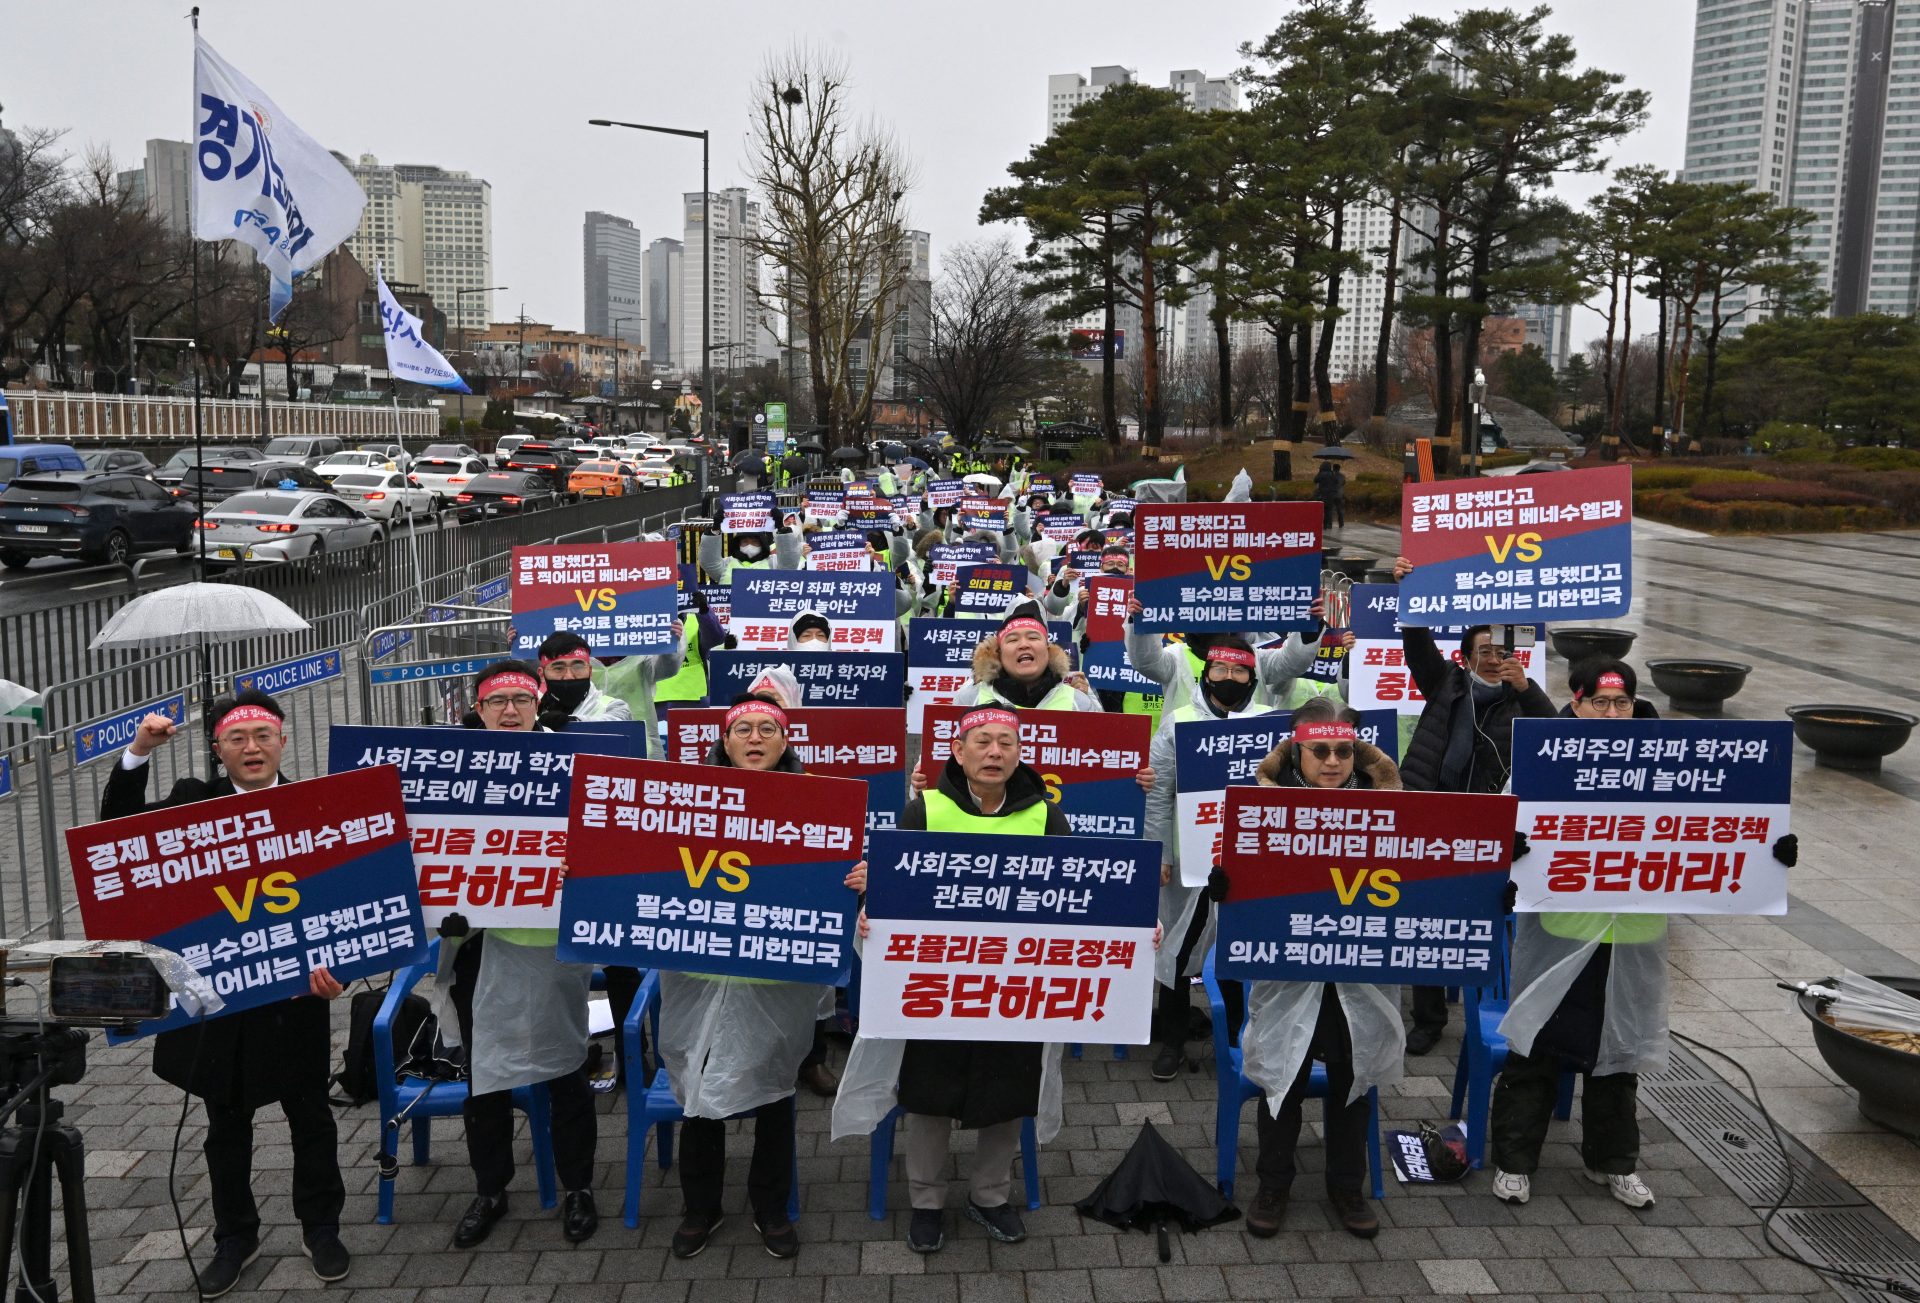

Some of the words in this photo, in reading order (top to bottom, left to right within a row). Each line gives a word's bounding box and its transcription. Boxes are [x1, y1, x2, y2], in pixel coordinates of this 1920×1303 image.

[1412, 494, 1449, 512] 경제
[1456, 488, 1534, 509] 망했다고
[729, 519, 767, 528] 중단하라!
[1144, 516, 1175, 531] 경제
[1181, 515, 1245, 531] 망했다고
[1412, 515, 1430, 532] 돈
[1435, 509, 1513, 530] 찍어내던
[1519, 500, 1622, 524] 베네수엘라
[1143, 534, 1159, 549] 돈
[1163, 533, 1228, 549] 찍어내던
[1233, 532, 1315, 547] 베네수엘라
[1485, 532, 1542, 563] VS
[520, 556, 548, 569] 경제
[553, 554, 610, 571] 망했다고
[812, 552, 837, 560] 포퓰리즘
[816, 560, 861, 571] 중단하라!
[1205, 554, 1251, 580] VS
[519, 572, 533, 585] 돈
[537, 570, 595, 584] 찍어내던
[600, 567, 671, 582] 베네수엘라
[747, 580, 803, 595] 사회주의
[807, 582, 836, 595] 좌파
[840, 582, 881, 596] 학자와
[969, 579, 990, 589] 의대
[993, 581, 1013, 590] 증원
[1456, 569, 1534, 589] 필수의료
[1540, 564, 1622, 585] 망했다고
[575, 588, 616, 611] VS
[768, 597, 812, 613] 관료에
[815, 599, 858, 616] 놀아난
[961, 592, 1015, 606] 중단하라
[1097, 587, 1126, 607] 경제
[1181, 587, 1244, 602] 필수의료
[1249, 586, 1315, 604] 망했다고
[1367, 597, 1399, 613] 사회
[1409, 596, 1448, 613] 의사
[1452, 592, 1532, 611] 찍어내는
[1539, 587, 1622, 607] 대한민국
[1095, 602, 1108, 616] 돈
[1141, 608, 1174, 622] 의사
[1178, 607, 1243, 621] 찍어내는
[1247, 606, 1312, 620] 대한민국
[554, 616, 611, 631] 필수의료
[615, 614, 673, 628] 망했다고
[614, 631, 671, 645] 대한민국
[832, 628, 883, 644] 료정책
[924, 630, 982, 648] 사회주의
[257, 667, 298, 690] POLICE
[300, 660, 322, 680] LINE
[402, 661, 473, 679] POLICE
[799, 664, 833, 679] 좌파
[838, 664, 887, 680] 학자와
[1089, 665, 1116, 680] 의사
[809, 684, 859, 699] 놀아난
[98, 721, 138, 748] POLIC
[679, 725, 719, 743] 경제
[1308, 726, 1335, 736] 의대증원
[798, 746, 897, 763] 베네수엘라
[932, 742, 951, 760] 돈
[1041, 747, 1141, 769] 베네수엘라
[1196, 732, 1276, 758] 사회주의
[1538, 738, 1634, 761] 사회주의
[1639, 739, 1688, 762] 좌파
[1696, 739, 1768, 763] 학자와
[356, 747, 463, 773] 사회주의
[469, 750, 522, 774] 좌파
[1574, 768, 1646, 791] 관료에
[1653, 768, 1726, 791] 놀아난
[484, 781, 560, 805] 놀아난
[585, 775, 636, 802] 경제
[644, 780, 745, 812] 망했다고
[582, 803, 607, 827] 돈
[614, 806, 717, 837] 찍어내던
[724, 816, 852, 850] 베네수엘라
[1237, 806, 1287, 828] 경제
[1295, 807, 1395, 831] 망했다고
[1530, 815, 1645, 841] 포퓰리즘
[1652, 816, 1769, 843] 의료정책
[87, 836, 149, 870] 경제
[156, 809, 275, 855] 망했다고
[413, 828, 475, 855] 리즘
[484, 829, 568, 860] 의료정
[1235, 833, 1260, 854] 돈
[1266, 833, 1367, 857] 찍어내던
[1375, 837, 1502, 862] 베네수엘라
[94, 872, 124, 900] 돈
[131, 845, 250, 888] 찍어내던
[258, 814, 395, 863] 베네수엘라
[679, 847, 751, 892] VS
[895, 852, 997, 878] 사회주의
[1003, 855, 1055, 880] 좌파
[1062, 857, 1136, 884] 학자와
[1548, 851, 1746, 893] 중단하라!
[214, 871, 300, 922] VS
[933, 885, 1010, 910] 관료에
[1017, 887, 1092, 913] 놀아난
[1330, 868, 1401, 907] VS
[637, 894, 736, 925] 필수의료
[744, 904, 843, 935] 망했다고
[180, 924, 297, 972] 필수의료
[302, 896, 410, 940] 망했다고
[1290, 914, 1387, 937] 필수의료
[1395, 917, 1492, 941] 망했다고
[307, 925, 414, 972] 대한민국
[572, 921, 624, 947] 의사
[630, 925, 732, 956] 찍어내는
[739, 935, 841, 967] 대한민국
[885, 934, 1007, 964] 포퓰리즘
[1014, 938, 1136, 969] 의료정책
[1229, 941, 1278, 963] 의사
[1285, 943, 1383, 966] 찍어내는
[1391, 946, 1490, 970] 대한민국
[902, 973, 1111, 1021] 중단하라!
